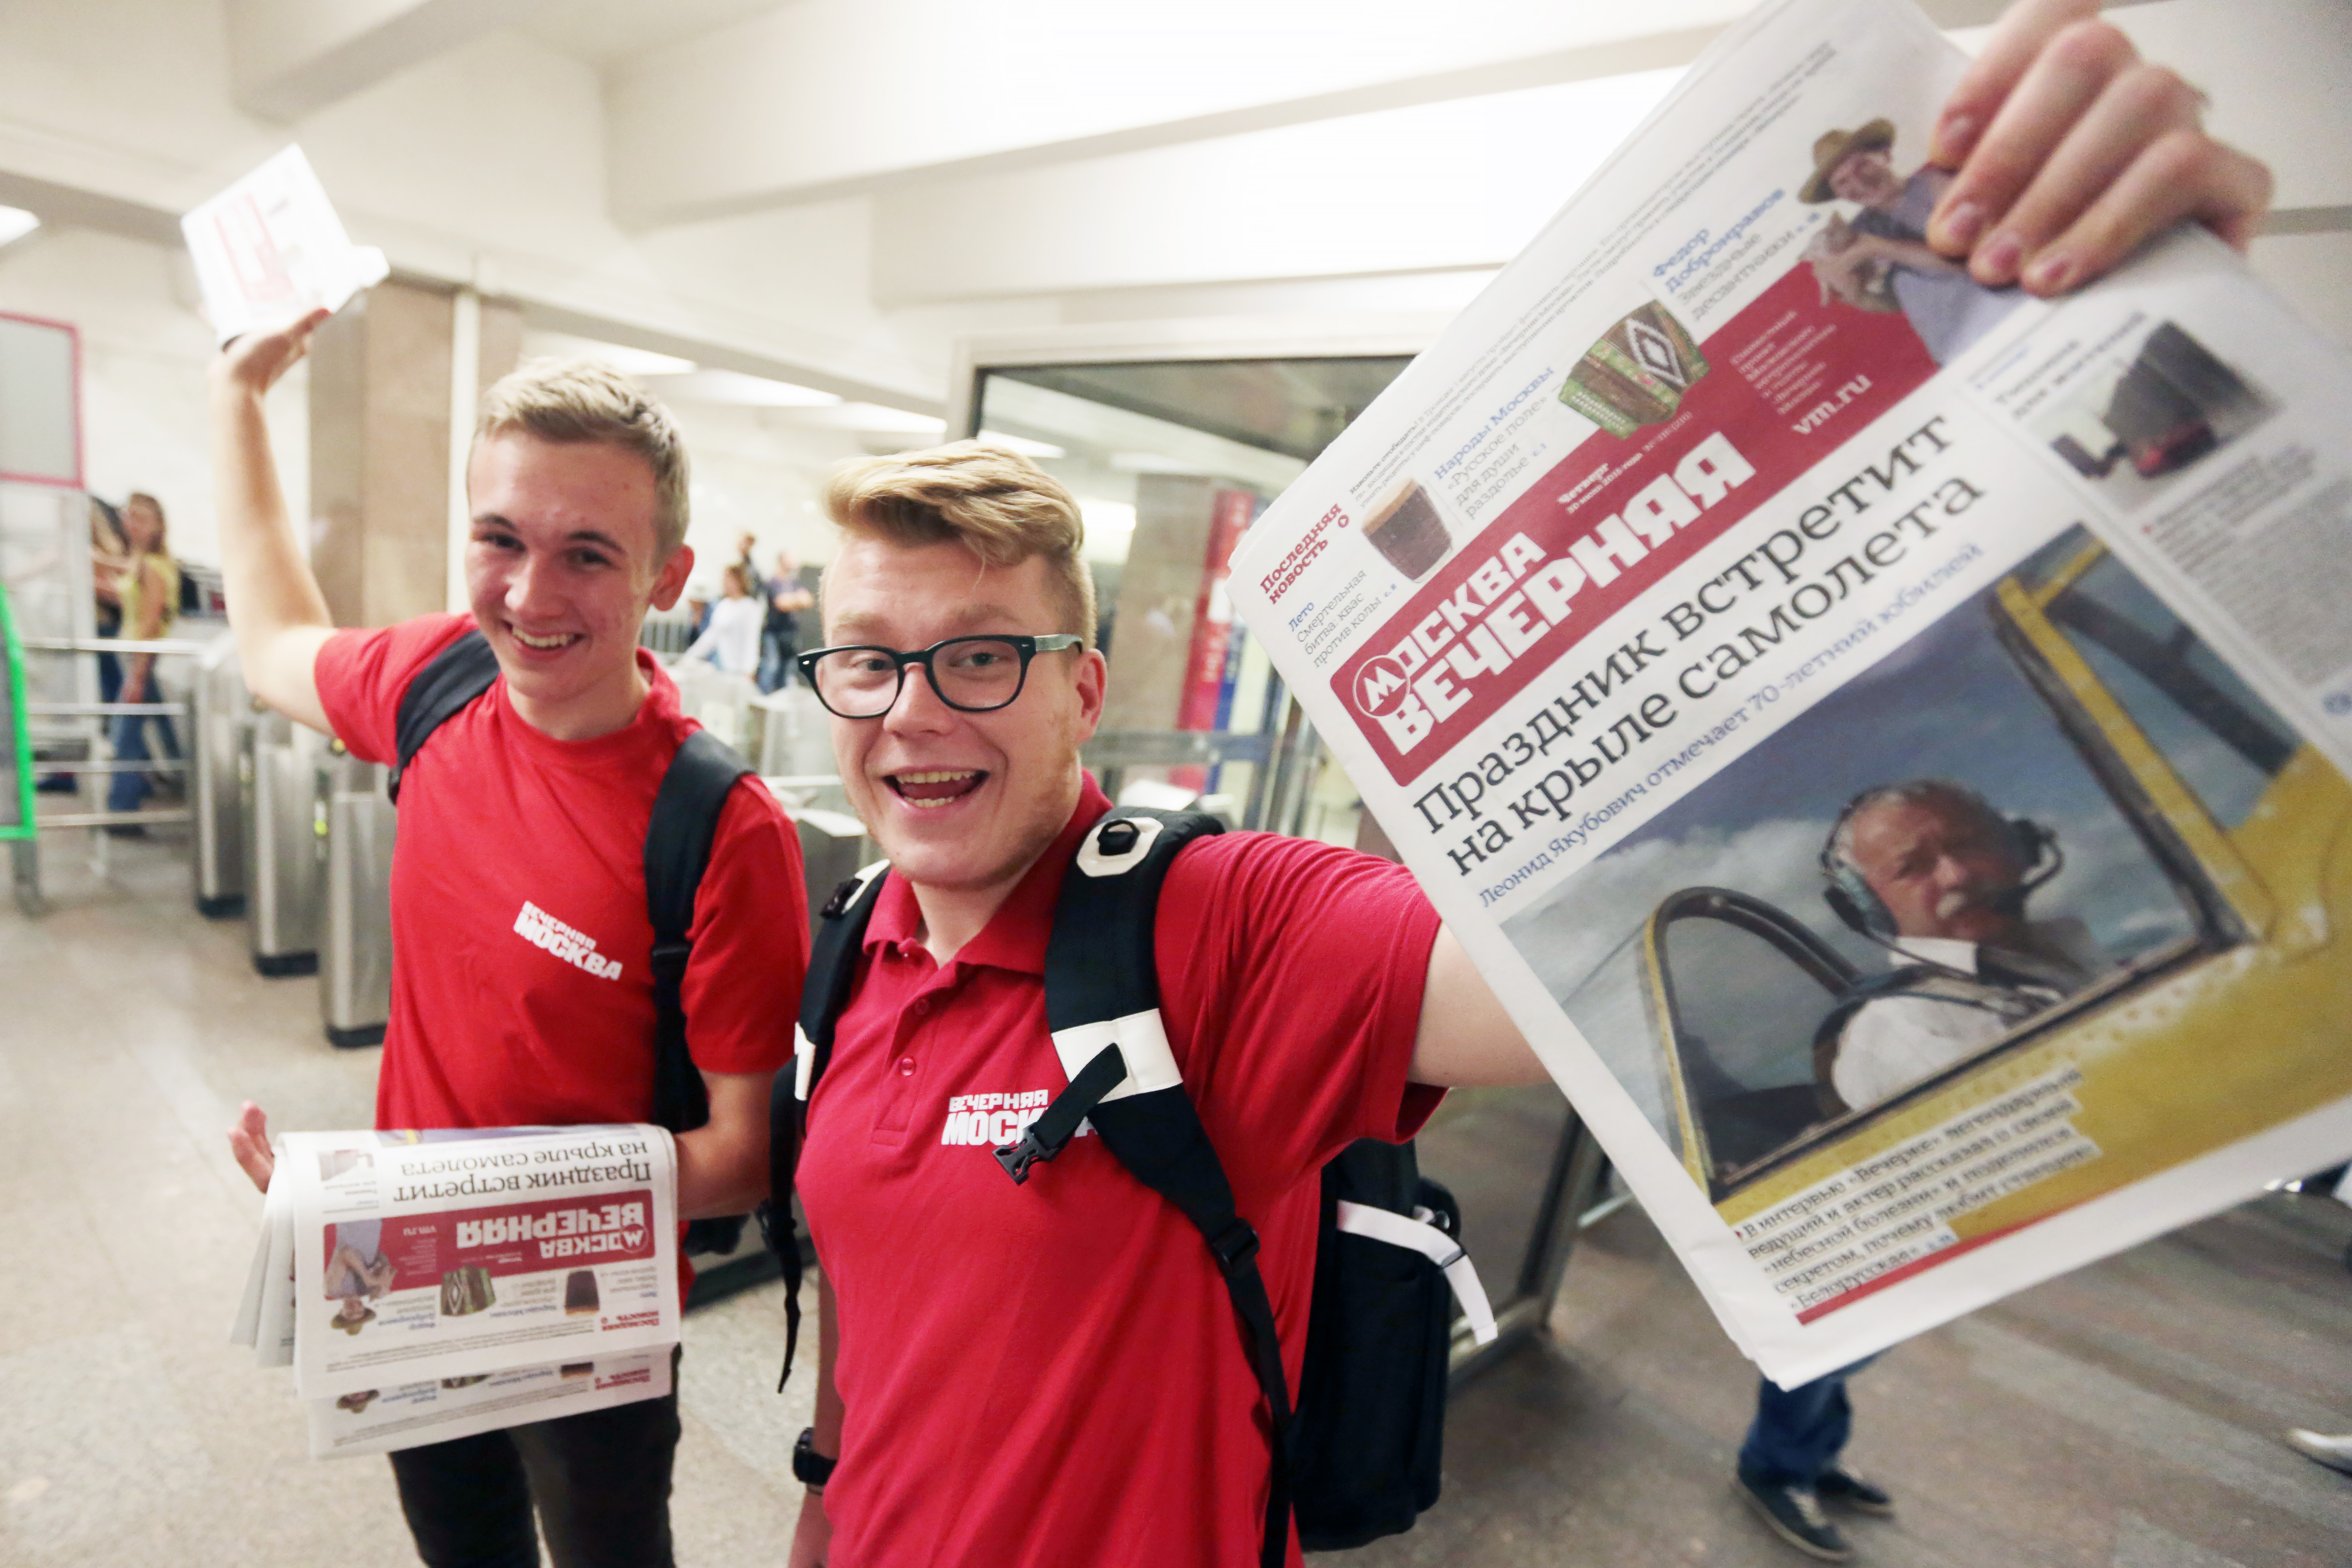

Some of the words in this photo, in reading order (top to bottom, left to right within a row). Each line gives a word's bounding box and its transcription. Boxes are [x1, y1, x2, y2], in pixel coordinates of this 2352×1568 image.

[1651, 226, 1713, 280] Федор
[1663, 186, 1786, 294] Добронравов
[1433, 423, 1493, 480] Народы
[1488, 365, 1555, 426] Москвы
[1789, 370, 1873, 438] vm.ru
[1349, 460, 1381, 494] Извольте
[1379, 420, 1420, 463] отобедать!
[1446, 432, 1508, 492] «Русское
[1504, 394, 1549, 436] поле»
[1453, 479, 1482, 508] для
[1479, 442, 1520, 483] души
[1465, 455, 1531, 520] раздолье
[1556, 461, 1612, 508] Четверг
[1258, 502, 1343, 594] Последняя
[1266, 536, 1330, 605] новость
[1286, 601, 1316, 632] Лето
[1295, 569, 1367, 643] Смертельная
[1336, 592, 1365, 621] квас
[1349, 527, 1548, 714] МОСКВА
[1371, 428, 1757, 757] ВЕЧЕРНЯЯ
[1410, 625, 1670, 835] Праздник
[1659, 412, 1960, 644] встретит
[1312, 626, 1353, 668] против
[1350, 596, 1382, 629] колы
[1445, 814, 1514, 877] на
[1506, 687, 1681, 831] крыле
[1673, 466, 1988, 705] самолета
[1477, 850, 1554, 908] Леонид
[1547, 781, 1648, 858] Якубович
[1644, 706, 1752, 789] отмечает
[1747, 613, 1880, 714] 70-летний
[1876, 537, 1985, 625] юбилей
[513, 911, 623, 980] МОСКВА
[949, 1089, 1048, 1112] ВЕЧЕРНЯЯ
[400, 1152, 528, 1177] самолета
[524, 1162, 652, 1190] Праздник
[533, 1144, 613, 1164] крыле
[618, 1141, 647, 1156] на
[392, 1175, 520, 1202] встретит
[1743, 1221, 1761, 1239] В
[1758, 1179, 1847, 1232] интервью
[1748, 1213, 1827, 1261] ведущий
[1825, 1206, 1843, 1224] и
[1843, 1181, 1896, 1216] актер
[454, 1201, 644, 1248] ВЕЧЕРНЯЯ
[538, 1229, 644, 1259] МОСКВА
[1774, 1246, 1867, 1296] секретом,
[1864, 1214, 1936, 1255] почему
